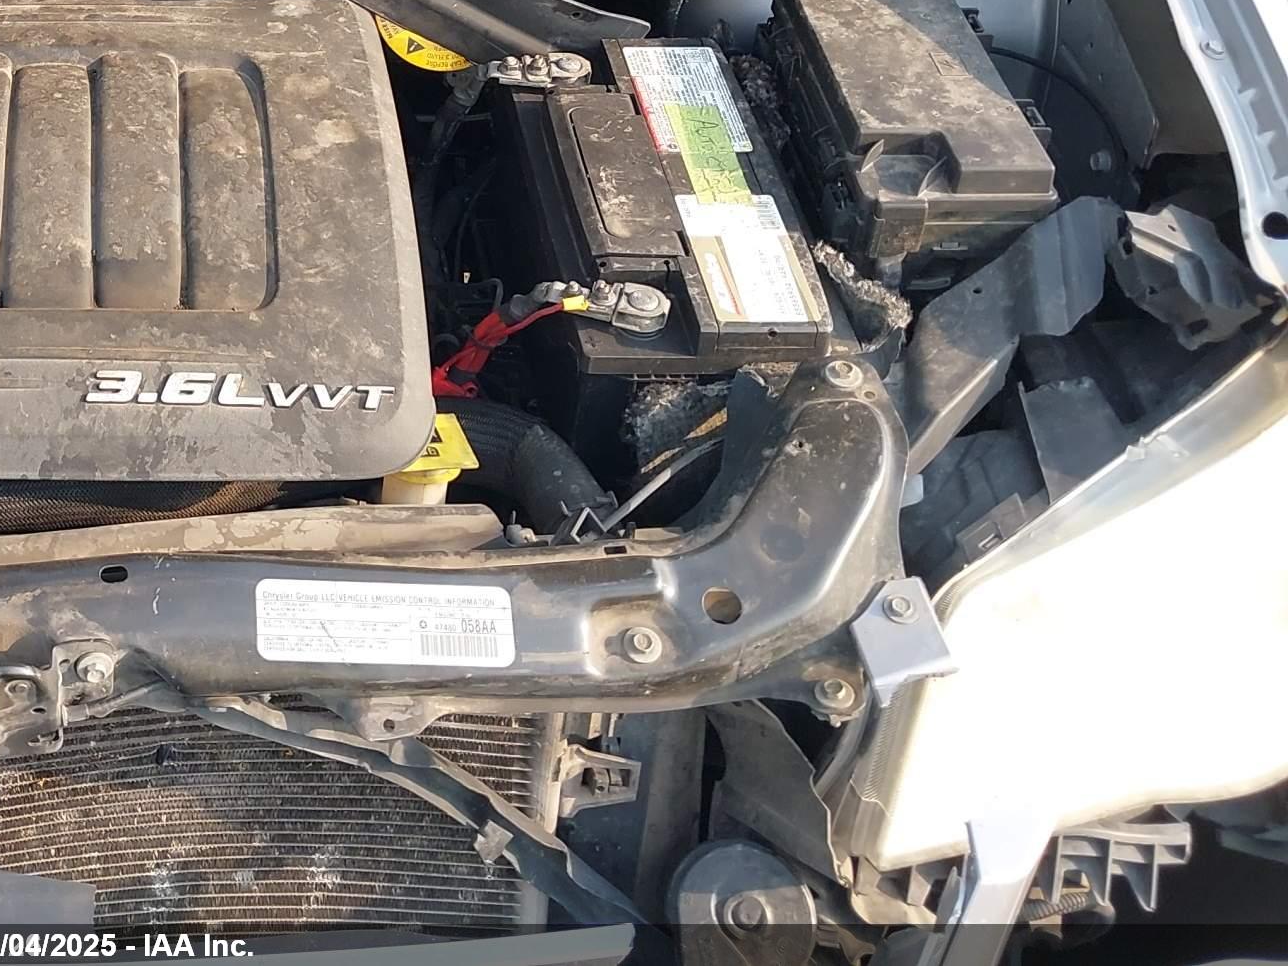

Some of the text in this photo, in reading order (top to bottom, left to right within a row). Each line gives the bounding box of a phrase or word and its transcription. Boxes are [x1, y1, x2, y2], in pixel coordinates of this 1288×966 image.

[263, 591, 293, 601] Chrysler
[296, 591, 319, 602] Group
[338, 593, 369, 602] VEHICLE
[370, 594, 406, 604] EMISSION
[408, 595, 441, 604] CONTROL
[444, 597, 495, 607] INFORMATION
